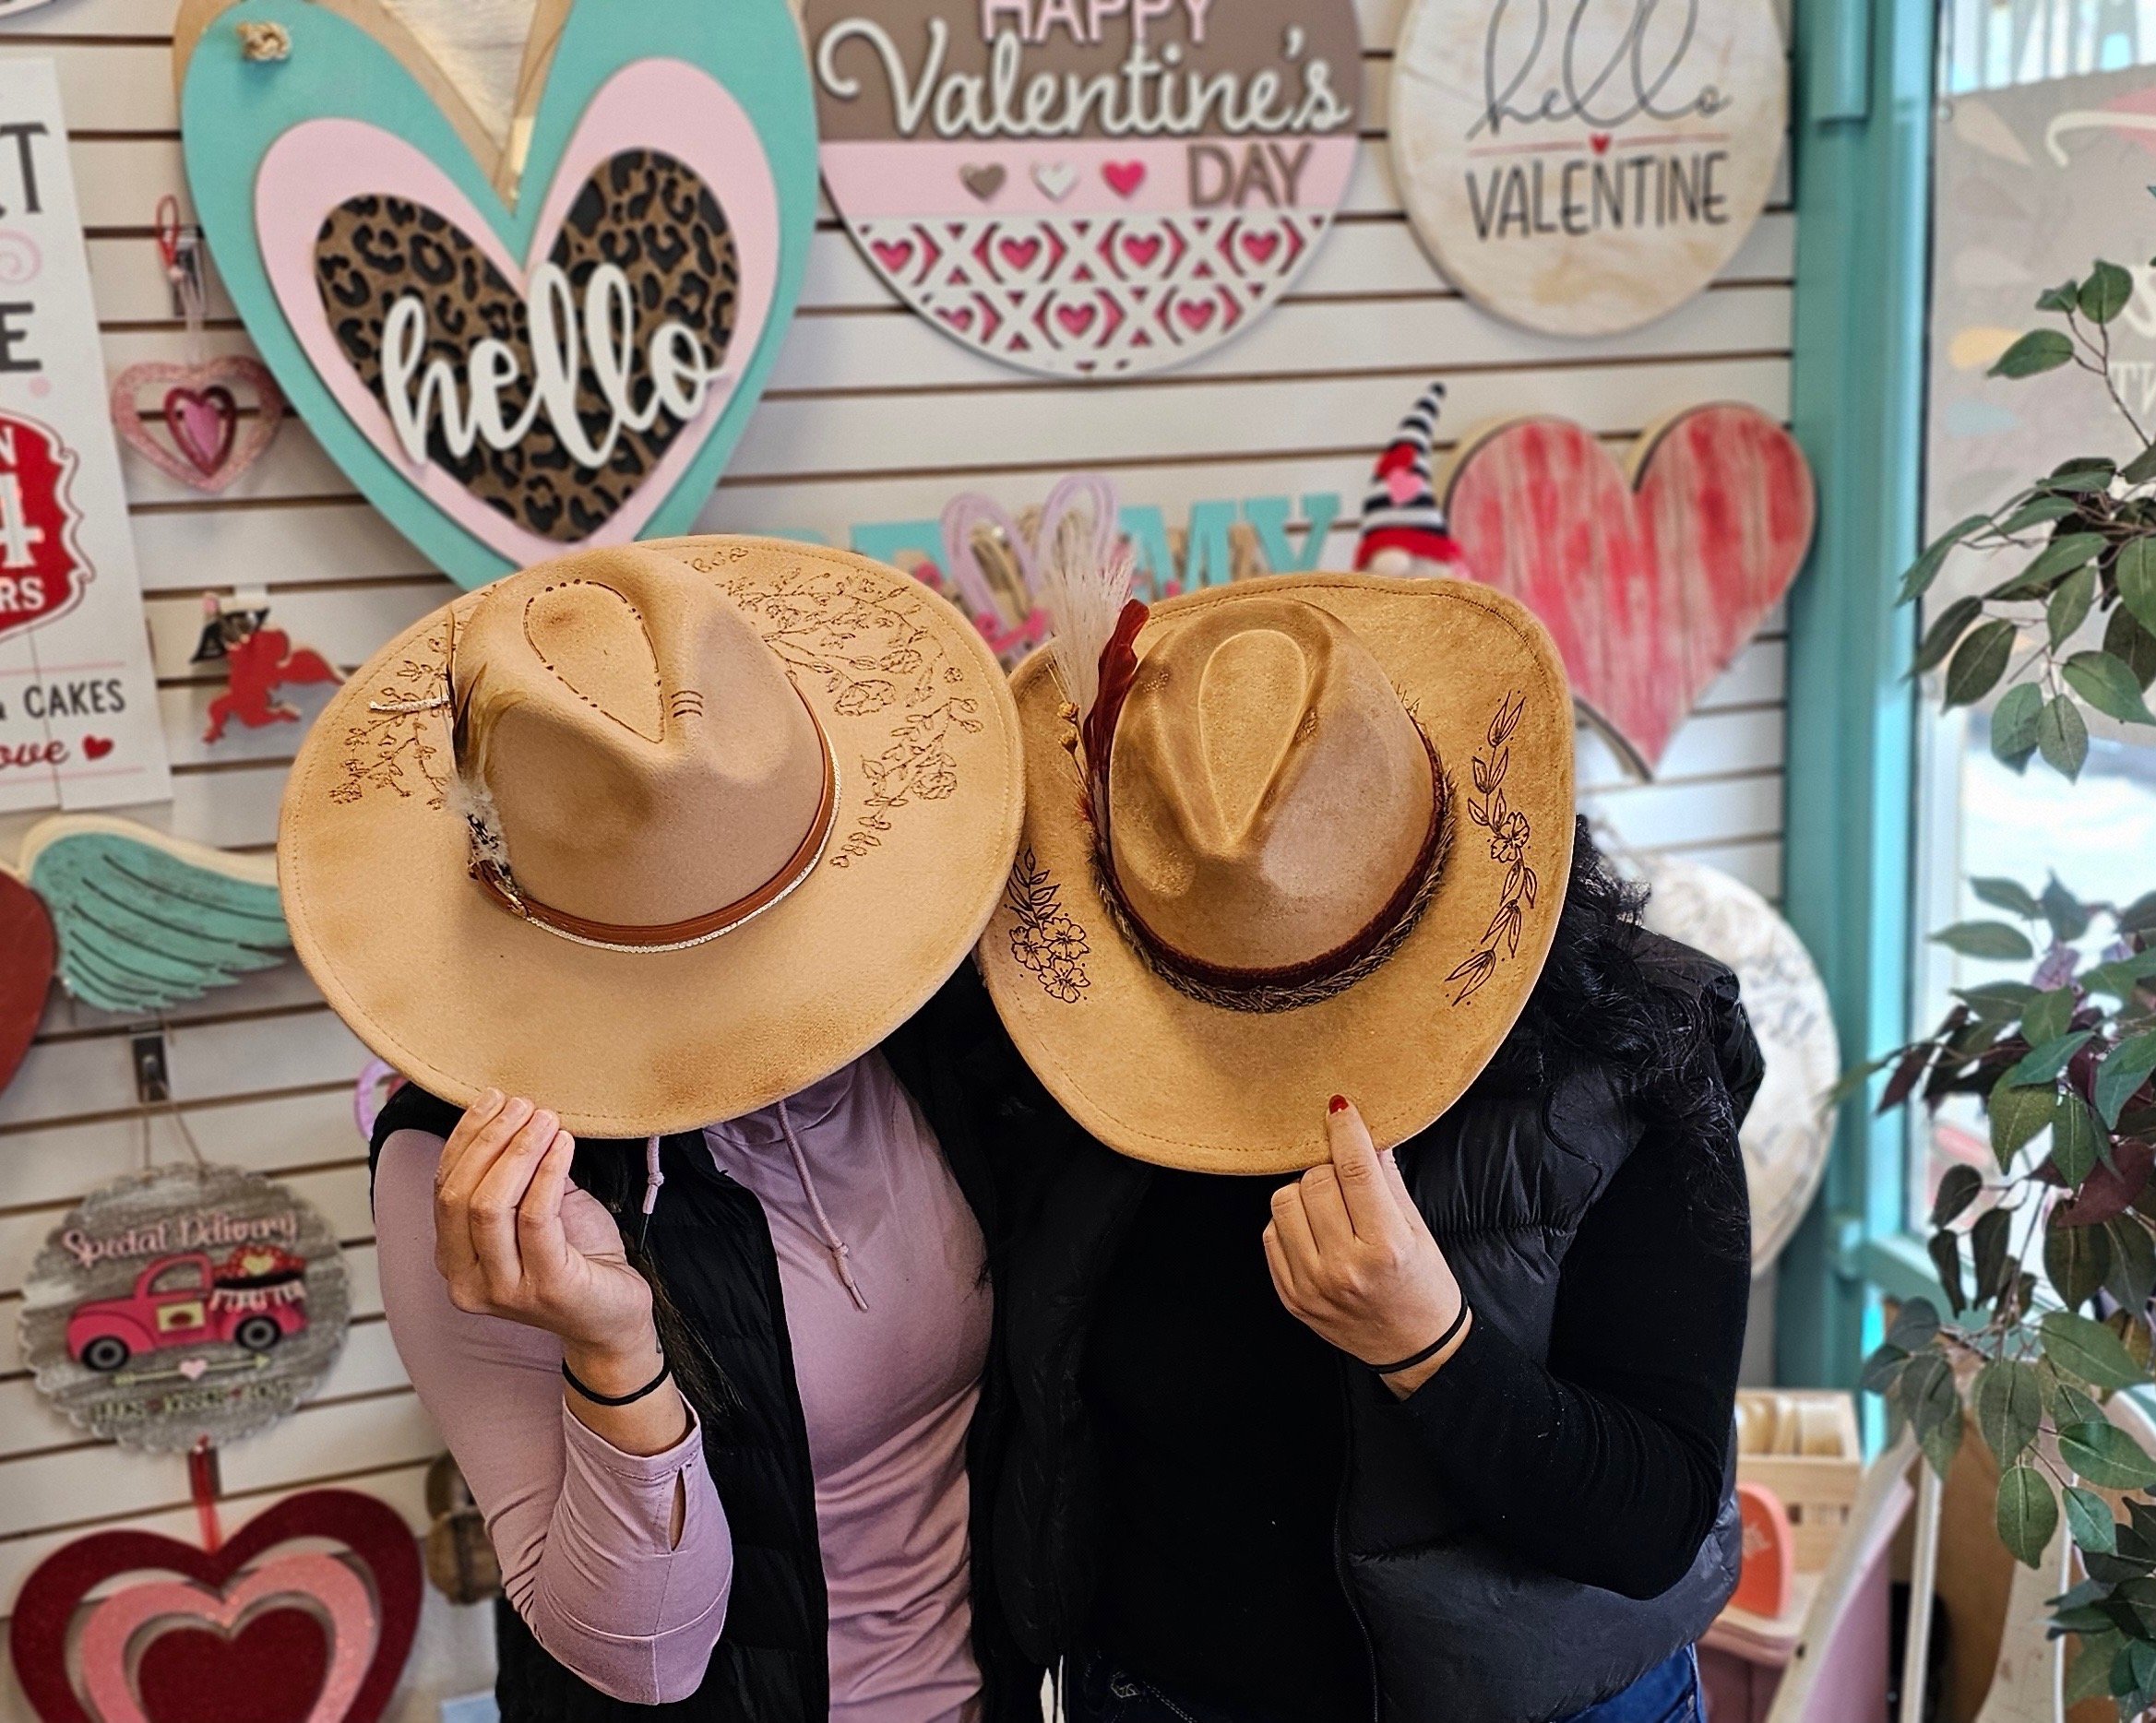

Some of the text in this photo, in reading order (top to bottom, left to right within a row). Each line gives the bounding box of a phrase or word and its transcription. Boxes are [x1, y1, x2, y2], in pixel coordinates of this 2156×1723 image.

[817, 18, 1352, 137] Valentine's
[1465, 0, 1732, 140] hello
[1186, 143, 1314, 208] DAY
[1465, 151, 1729, 241] VALENTINE
[381, 263, 732, 468] hello
[22, 678, 126, 719] CAKES
